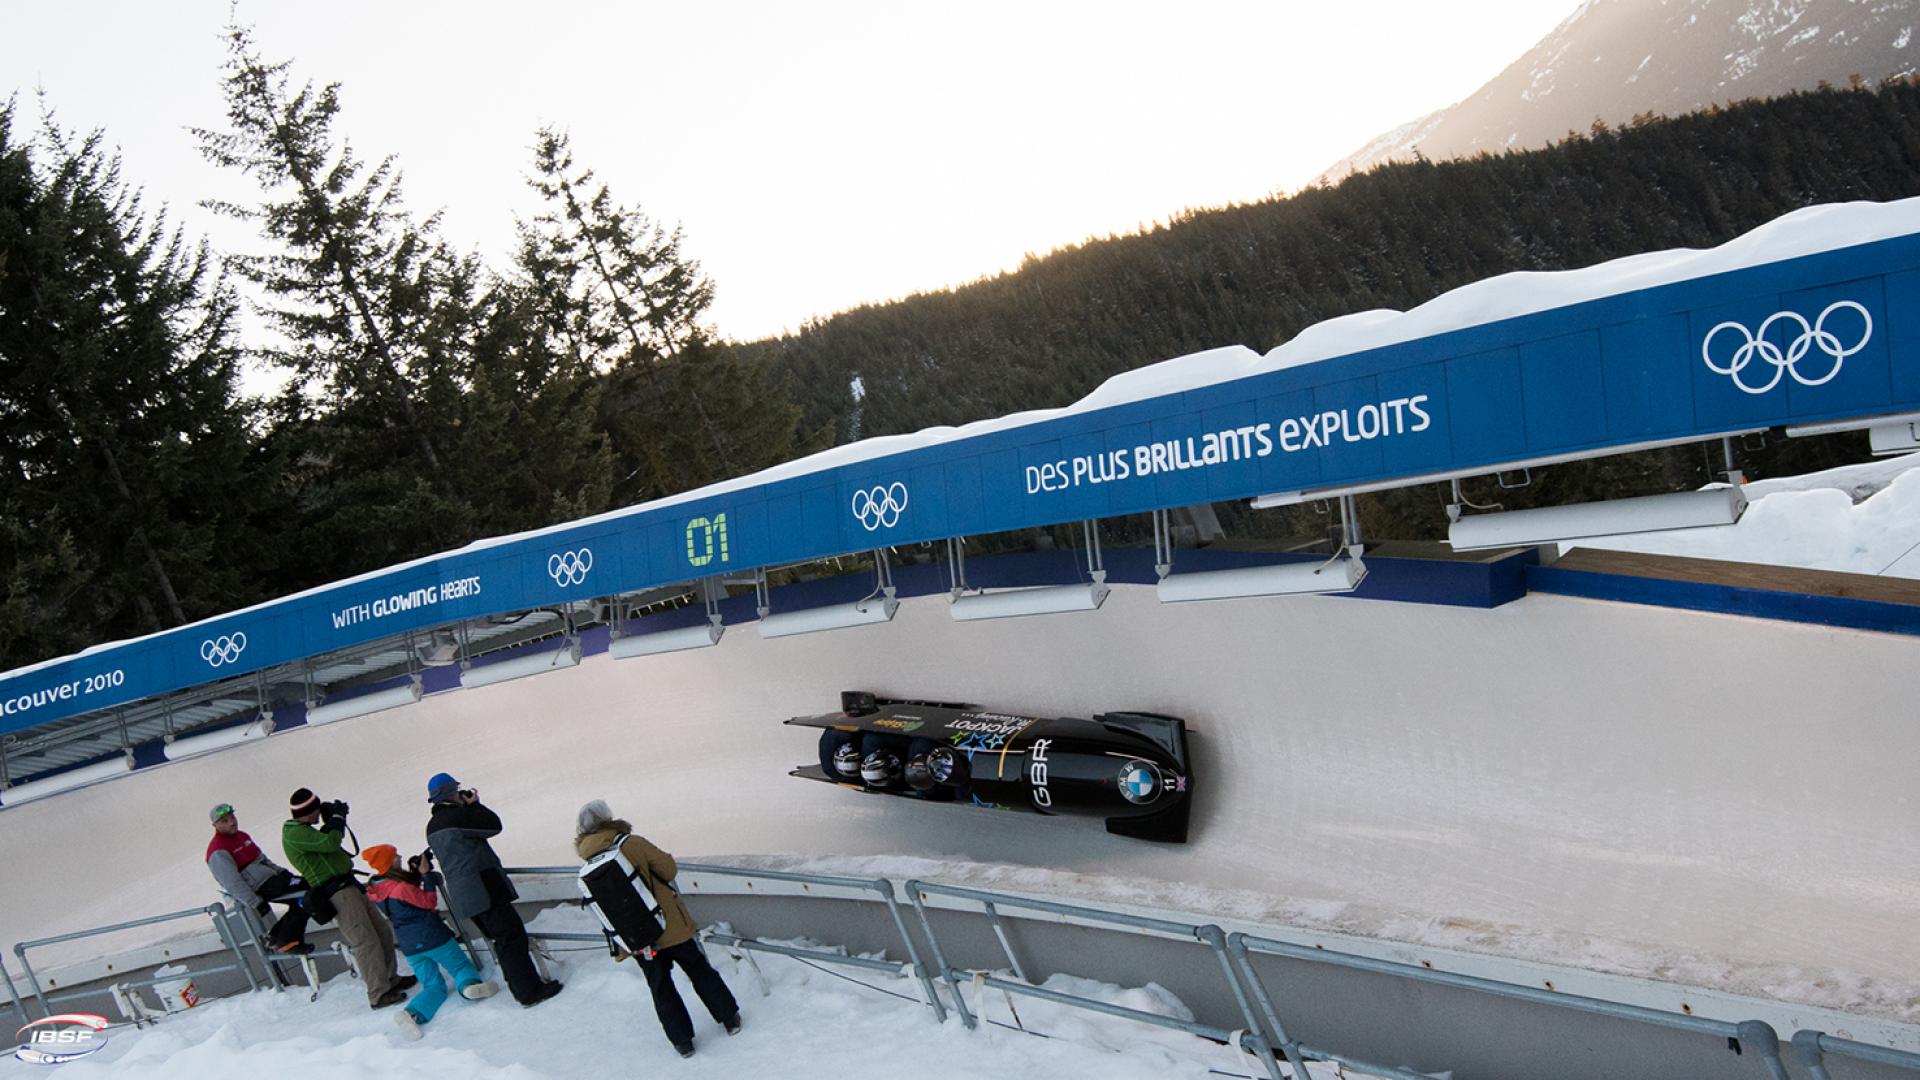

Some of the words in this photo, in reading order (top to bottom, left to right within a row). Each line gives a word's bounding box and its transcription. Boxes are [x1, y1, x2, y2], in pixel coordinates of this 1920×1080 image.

[1073, 449, 1130, 486] PLUS
[686, 512, 729, 567] 01
[332, 603, 370, 629] WITH
[84, 669, 125, 694] 2010
[944, 719, 1022, 736] JACKPOT
[1030, 738, 1053, 807] GBR
